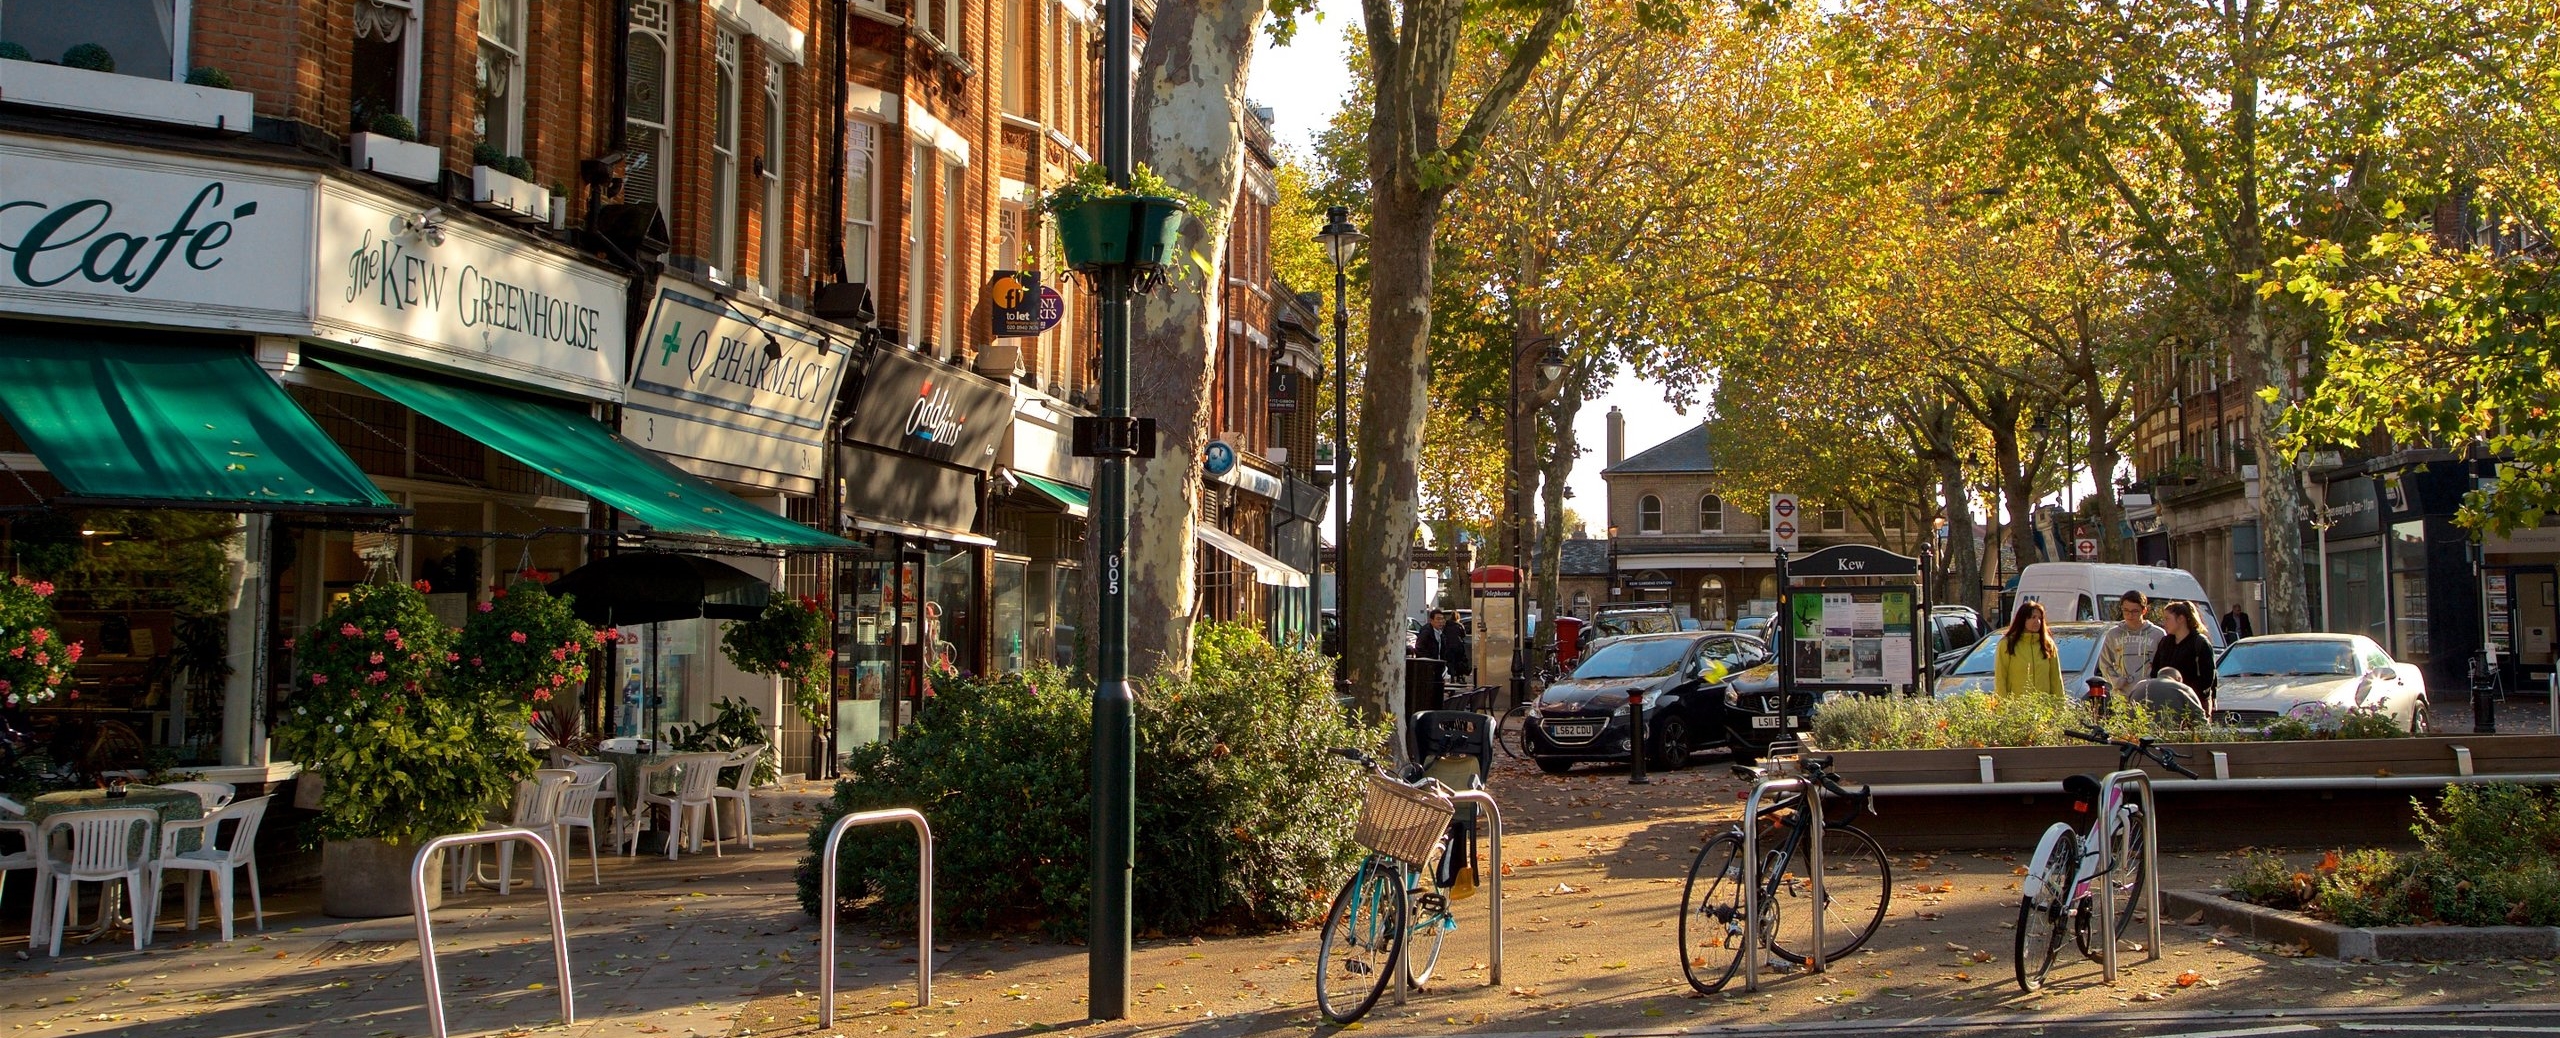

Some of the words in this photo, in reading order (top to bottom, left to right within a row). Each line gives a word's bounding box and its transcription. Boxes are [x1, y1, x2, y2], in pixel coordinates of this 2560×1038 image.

[0, 182, 257, 293] Café
[346, 228, 380, 303] The
[380, 239, 448, 312] KEW
[458, 265, 600, 352] GREENHOUSE
[1006, 312, 1015, 321] to
[1016, 311, 1030, 321] let
[688, 330, 708, 384] Q
[709, 336, 830, 403] PHARMACY
[905, 386, 963, 447] Oddbins
[647, 417, 654, 442] 3
[1838, 558, 1865, 571] Kew
[1484, 590, 1511, 598] Telephone
[1556, 726, 1574, 735] LS62
[1774, 718, 1791, 727] EK
